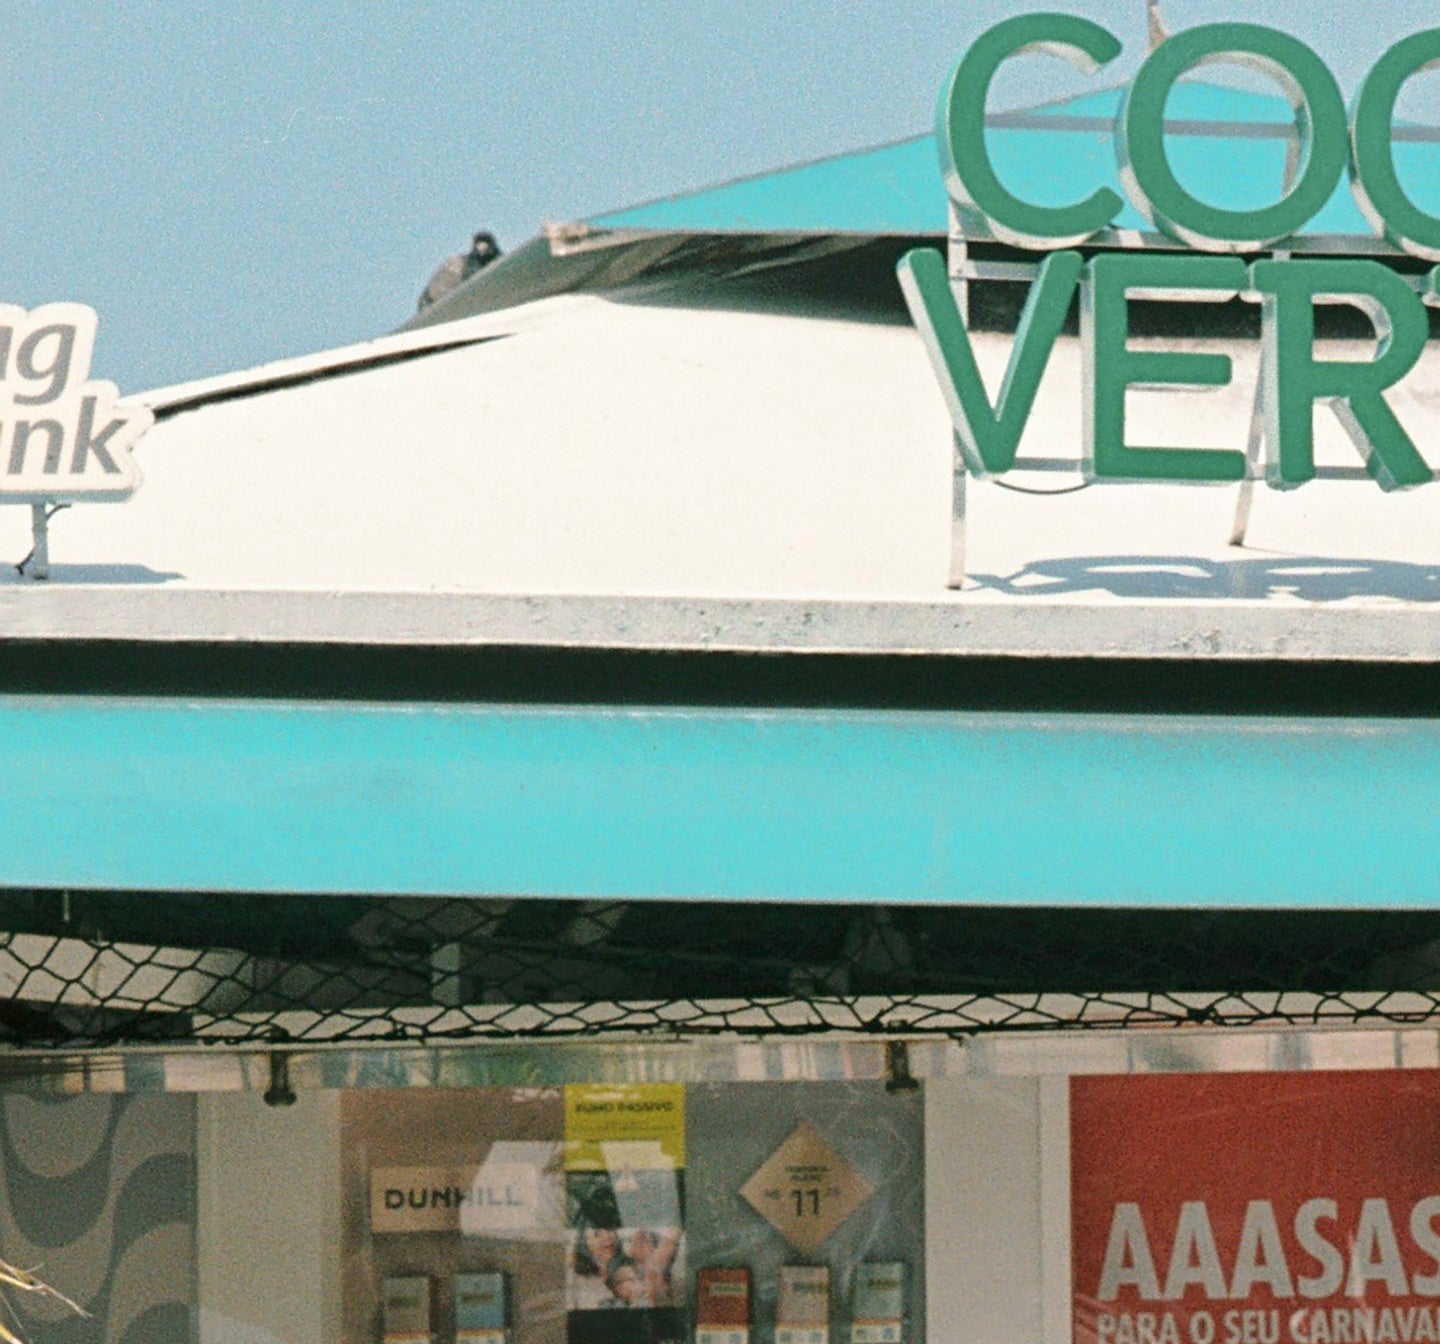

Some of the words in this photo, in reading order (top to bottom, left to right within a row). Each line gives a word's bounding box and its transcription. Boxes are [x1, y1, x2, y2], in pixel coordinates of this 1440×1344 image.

[0, 396, 128, 475] nk
[385, 1187, 522, 1209] DUNHILL
[792, 1188, 820, 1217] 11
